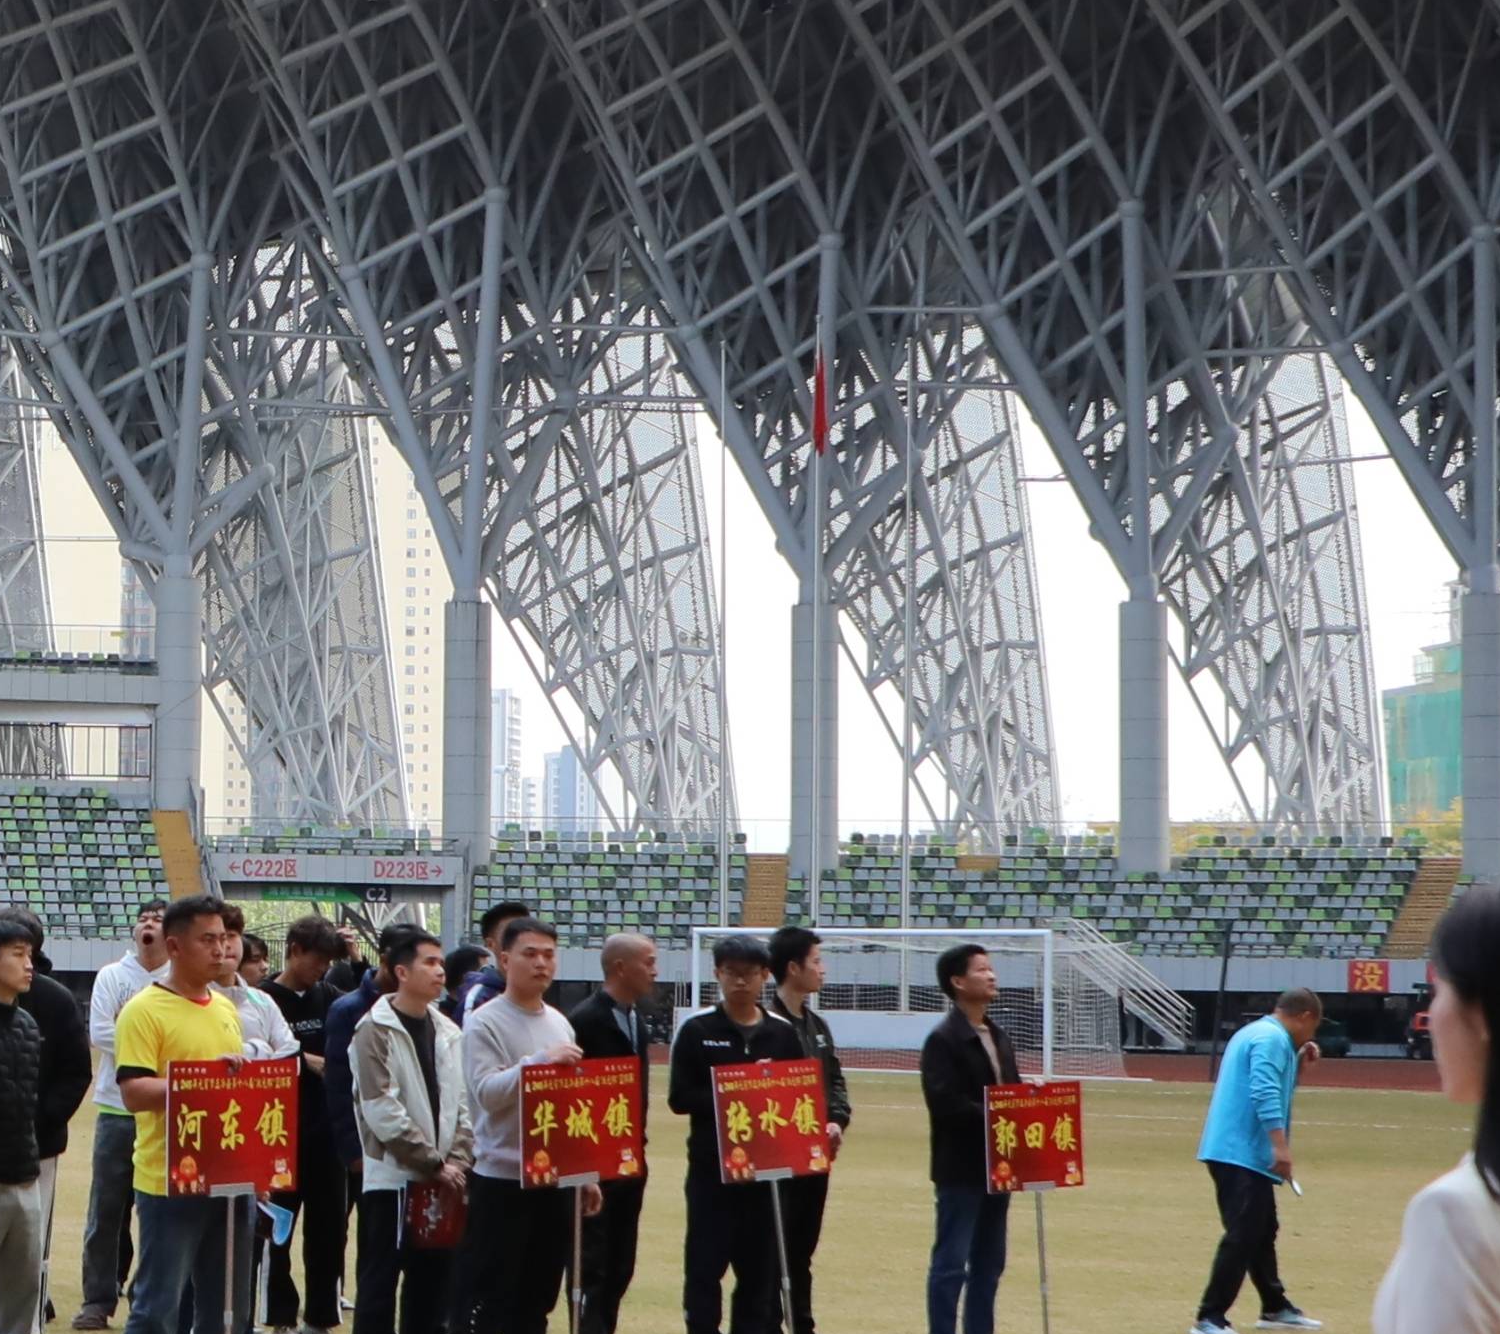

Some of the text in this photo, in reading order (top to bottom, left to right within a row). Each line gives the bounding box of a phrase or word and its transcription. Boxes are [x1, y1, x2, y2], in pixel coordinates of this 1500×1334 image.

[242, 858, 297, 878] C222区
[374, 860, 429, 880] D223区
[365, 887, 387, 902] C2
[1352, 961, 1384, 992] 没
[176, 1097, 289, 1152] 河东镇
[528, 1092, 633, 1148] 华城镇
[725, 1092, 821, 1145] 转水镇
[991, 1112, 1077, 1160] 郭田镇
